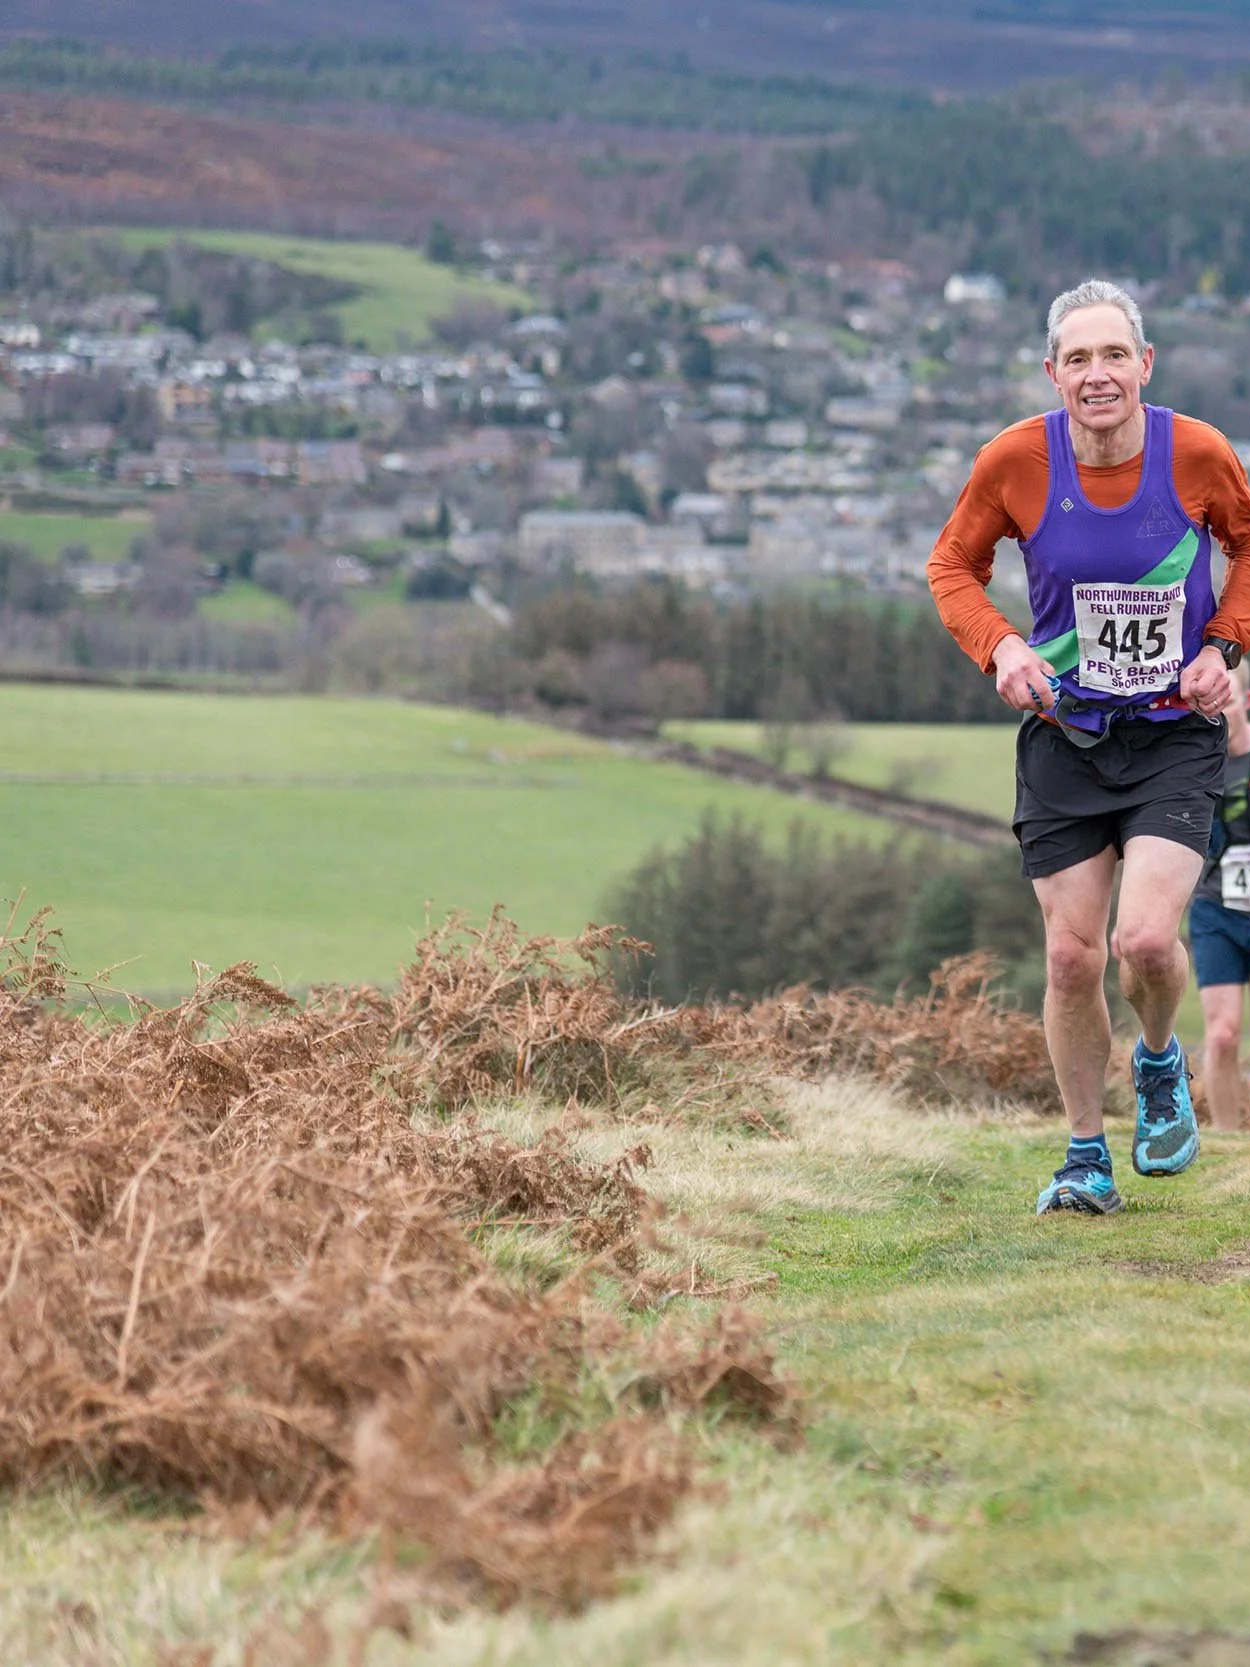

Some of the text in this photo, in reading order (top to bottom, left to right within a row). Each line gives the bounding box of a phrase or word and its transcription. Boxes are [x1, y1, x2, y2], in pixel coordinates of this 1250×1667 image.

[1076, 586, 1181, 602] NORTHUMBERLAND
[1091, 603, 1171, 615] FELL RUNNERS
[1098, 617, 1168, 662] 445
[1086, 659, 1181, 680] PETE BLAND
[1112, 675, 1156, 689] SPORTS
